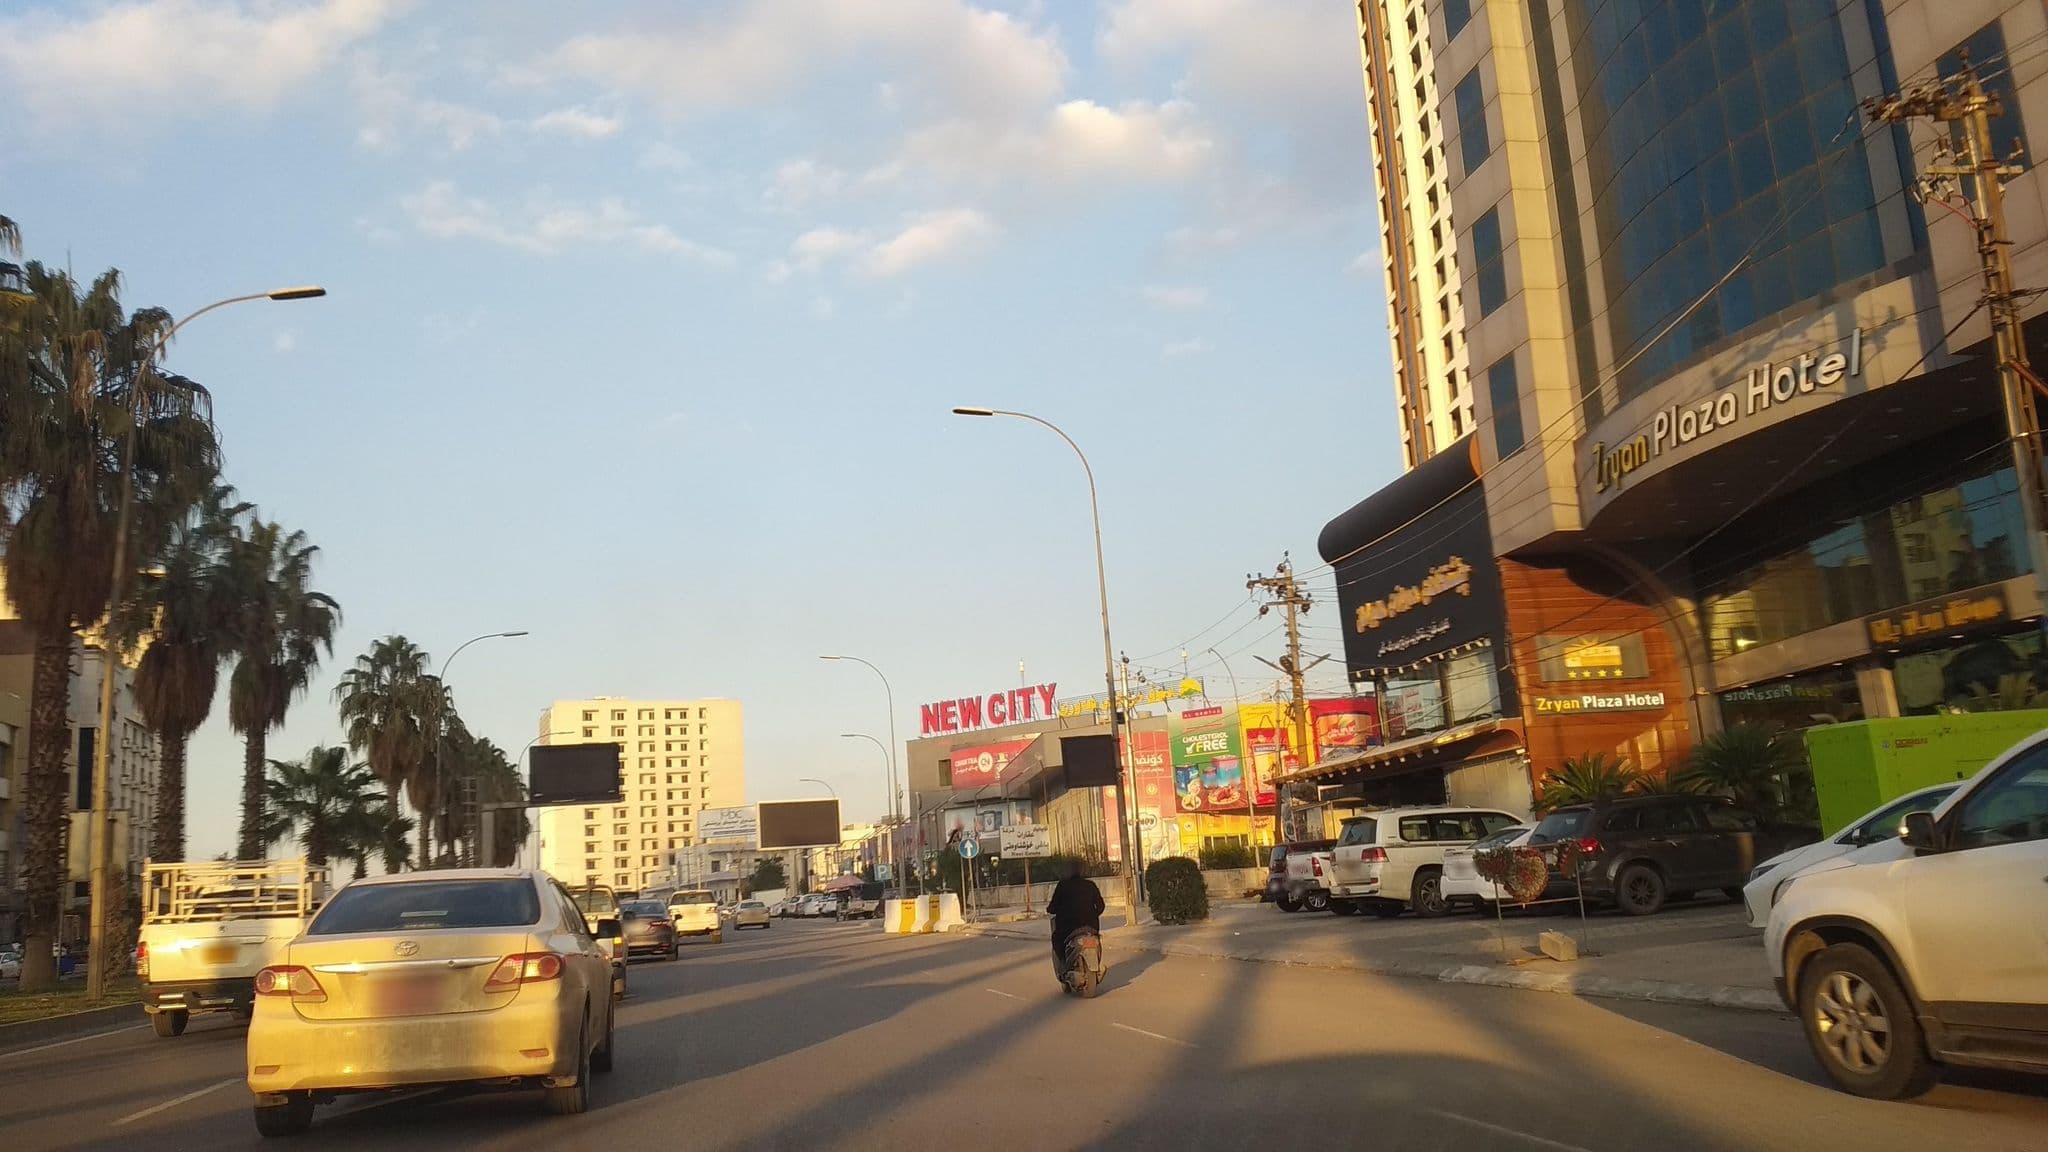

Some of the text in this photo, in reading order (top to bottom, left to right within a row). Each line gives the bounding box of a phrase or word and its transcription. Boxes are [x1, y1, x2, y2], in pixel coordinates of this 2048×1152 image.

[1592, 327, 1863, 494] Zryan Plaza Hotel
[921, 696, 982, 734] NEW
[987, 683, 1057, 726] CITY
[1536, 693, 1664, 712] Zryan Plaza Hotel
[1183, 732, 1228, 744] CHOLESTEROL
[1196, 739, 1228, 753] FREE
[878, 865, 887, 878] P
